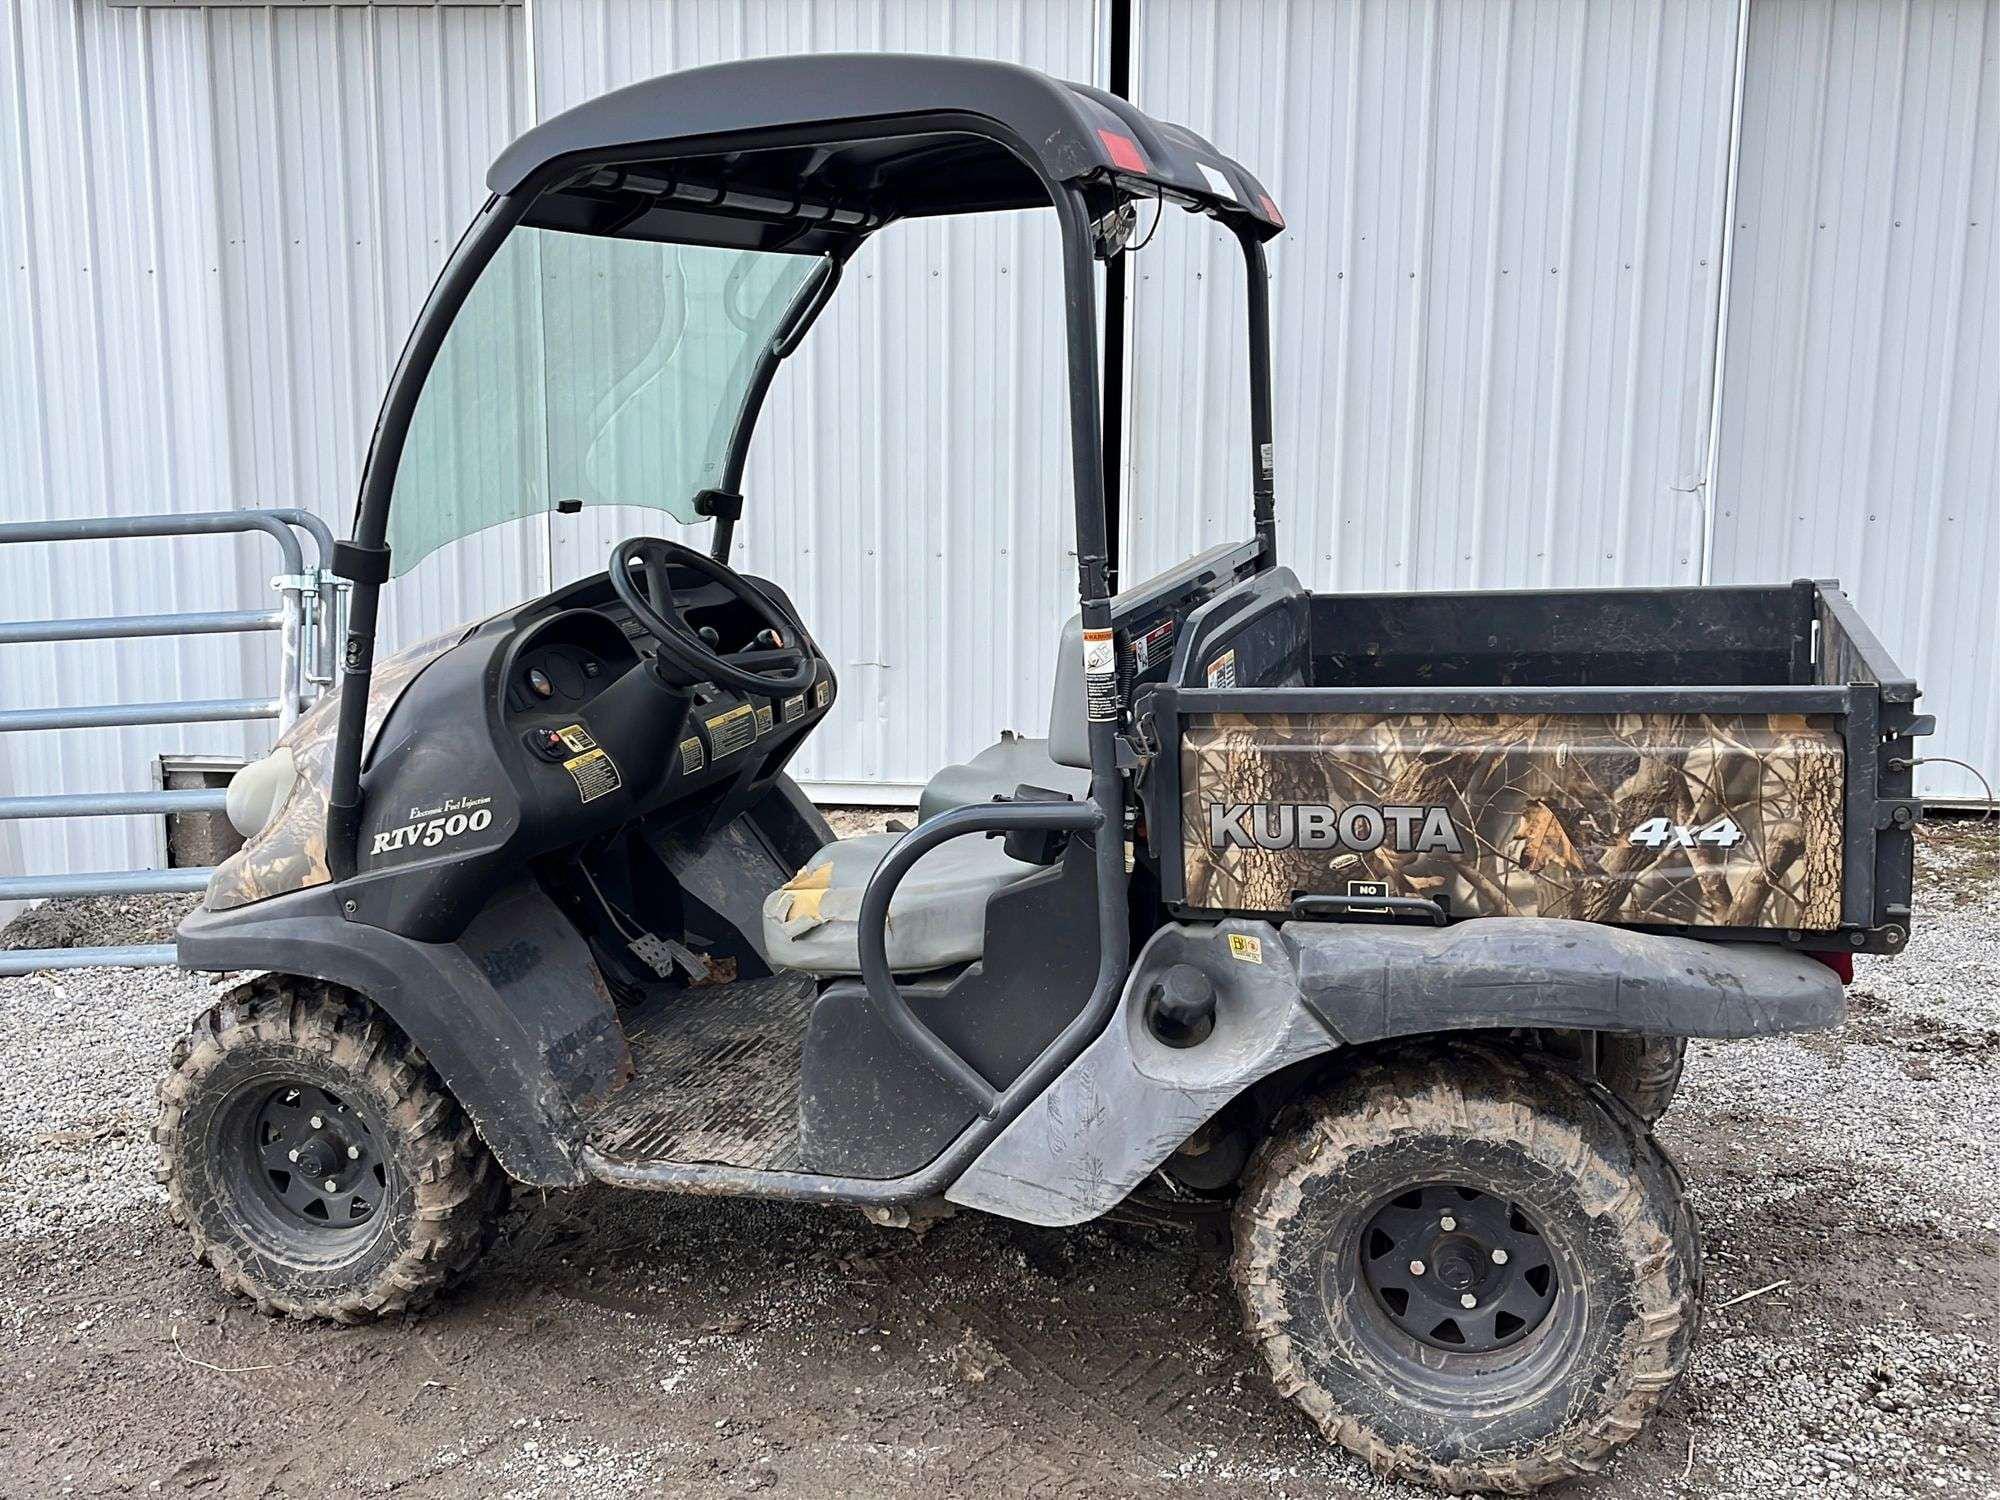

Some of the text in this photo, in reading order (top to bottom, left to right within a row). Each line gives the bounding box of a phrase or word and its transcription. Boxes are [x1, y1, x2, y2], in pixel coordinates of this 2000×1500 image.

[443, 799, 461, 812] Fuel
[461, 796, 491, 809] Injection
[370, 809, 492, 855] RTV500
[1210, 803, 1464, 853] KUBOTA
[1629, 818, 1744, 849] 4x4
[1359, 885, 1377, 895] NO
